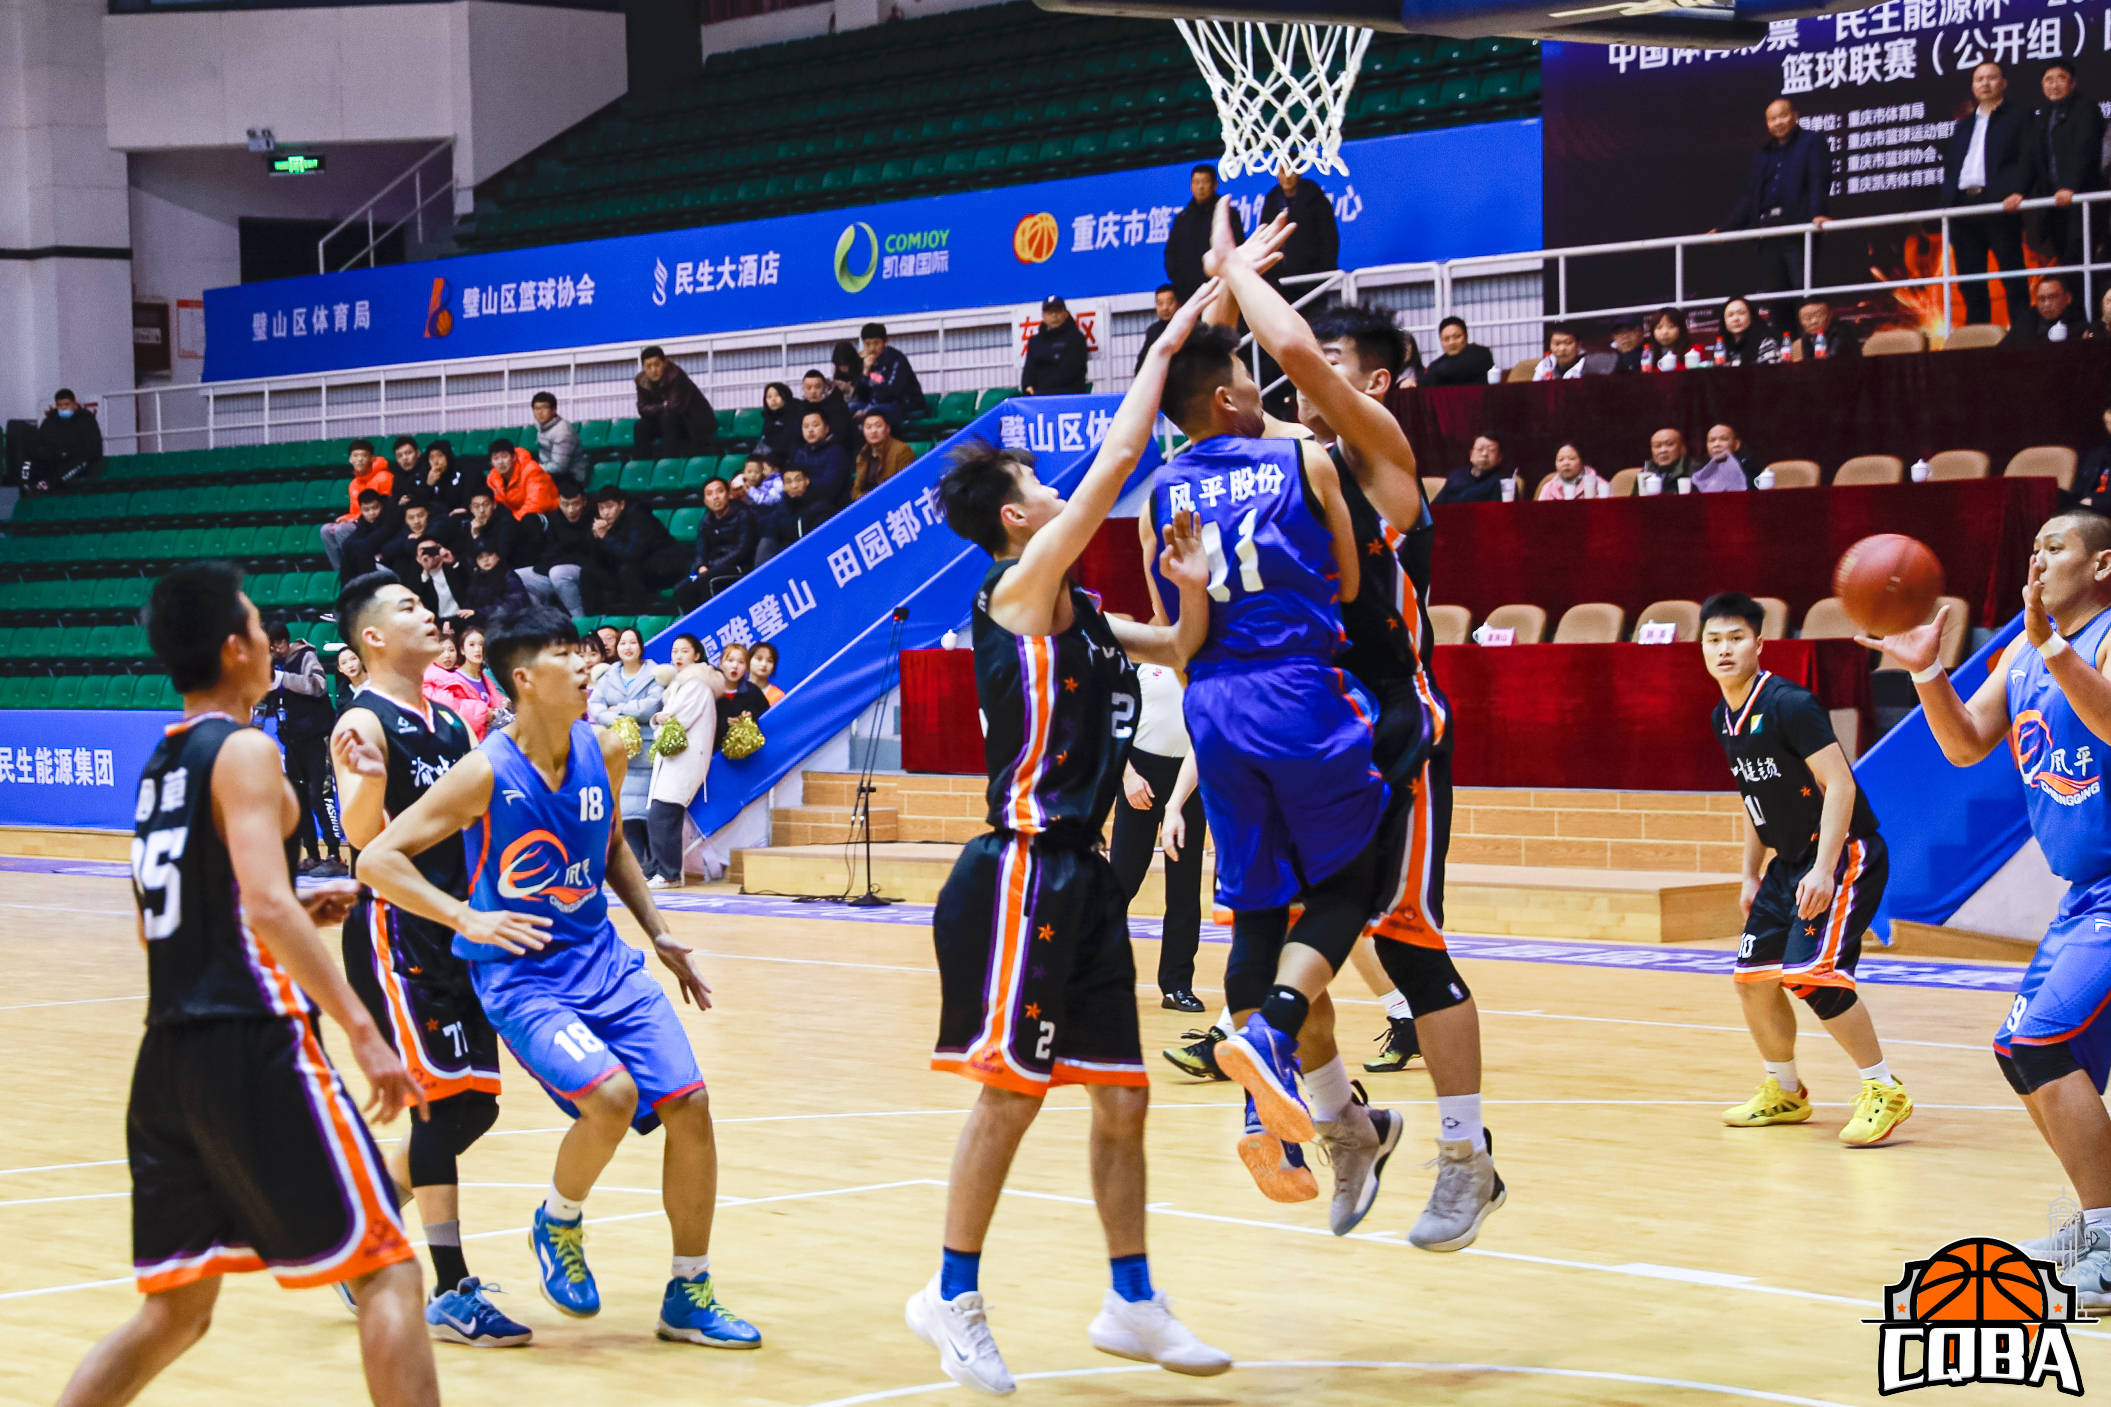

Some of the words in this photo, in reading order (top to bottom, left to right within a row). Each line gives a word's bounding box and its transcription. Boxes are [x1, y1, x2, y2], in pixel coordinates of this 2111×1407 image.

[885, 229, 950, 253] COMJOY
[674, 251, 780, 296] 民生大酒店
[882, 250, 949, 279] 凯健国际
[462, 273, 595, 318] 璧山区篮球协会
[252, 300, 371, 341] 璧山区体育局
[1169, 463, 1285, 519] 风平股份
[1201, 508, 1264, 602] 11
[1111, 692, 1135, 738] 2
[0, 747, 115, 787] 民生能源集团
[579, 786, 605, 822] 18
[554, 1021, 605, 1063] 18
[1035, 1020, 1056, 1060] 2
